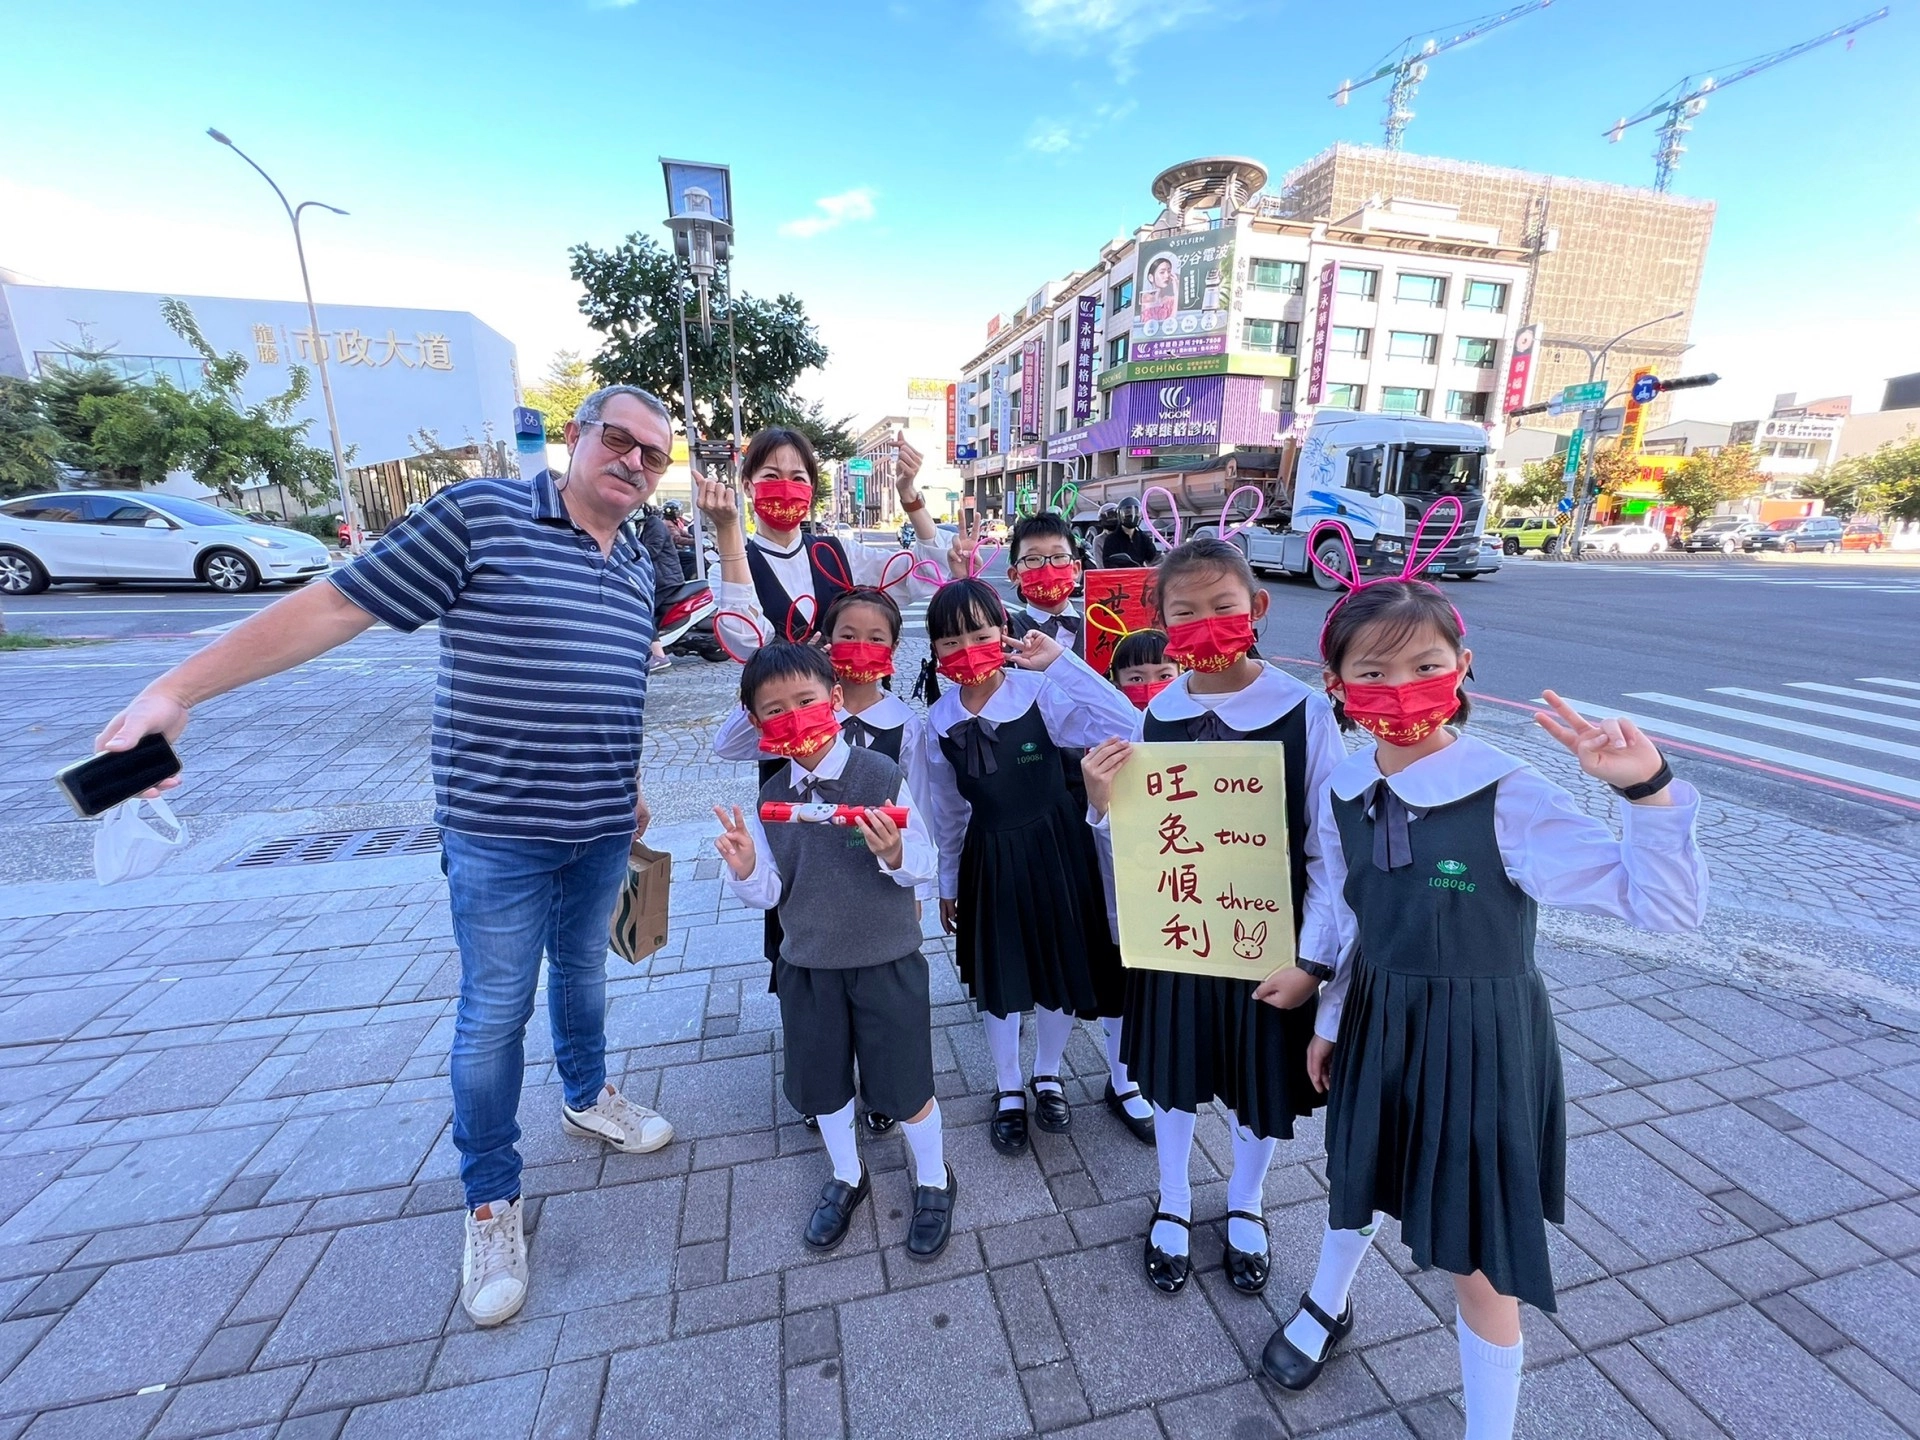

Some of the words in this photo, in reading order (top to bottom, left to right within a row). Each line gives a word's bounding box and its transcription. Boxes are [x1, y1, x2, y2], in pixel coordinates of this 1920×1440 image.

[1176, 236, 1205, 247] SYLFIRM
[1177, 244, 1230, 269] 矽谷電波
[252, 323, 280, 365] 龍騰
[291, 327, 454, 371] 市政大道
[1309, 293, 1329, 398] 永華維格診所
[1076, 321, 1092, 413] 永華維格診所
[1134, 362, 1183, 375] BOCHING
[1158, 410, 1190, 419] VIGOR
[1130, 420, 1217, 438] 永華維格診所
[1016, 753, 1044, 765] 109081
[1213, 776, 1264, 793] one
[1214, 828, 1267, 847] two
[1428, 876, 1477, 893] 108086
[1216, 882, 1280, 913] three
